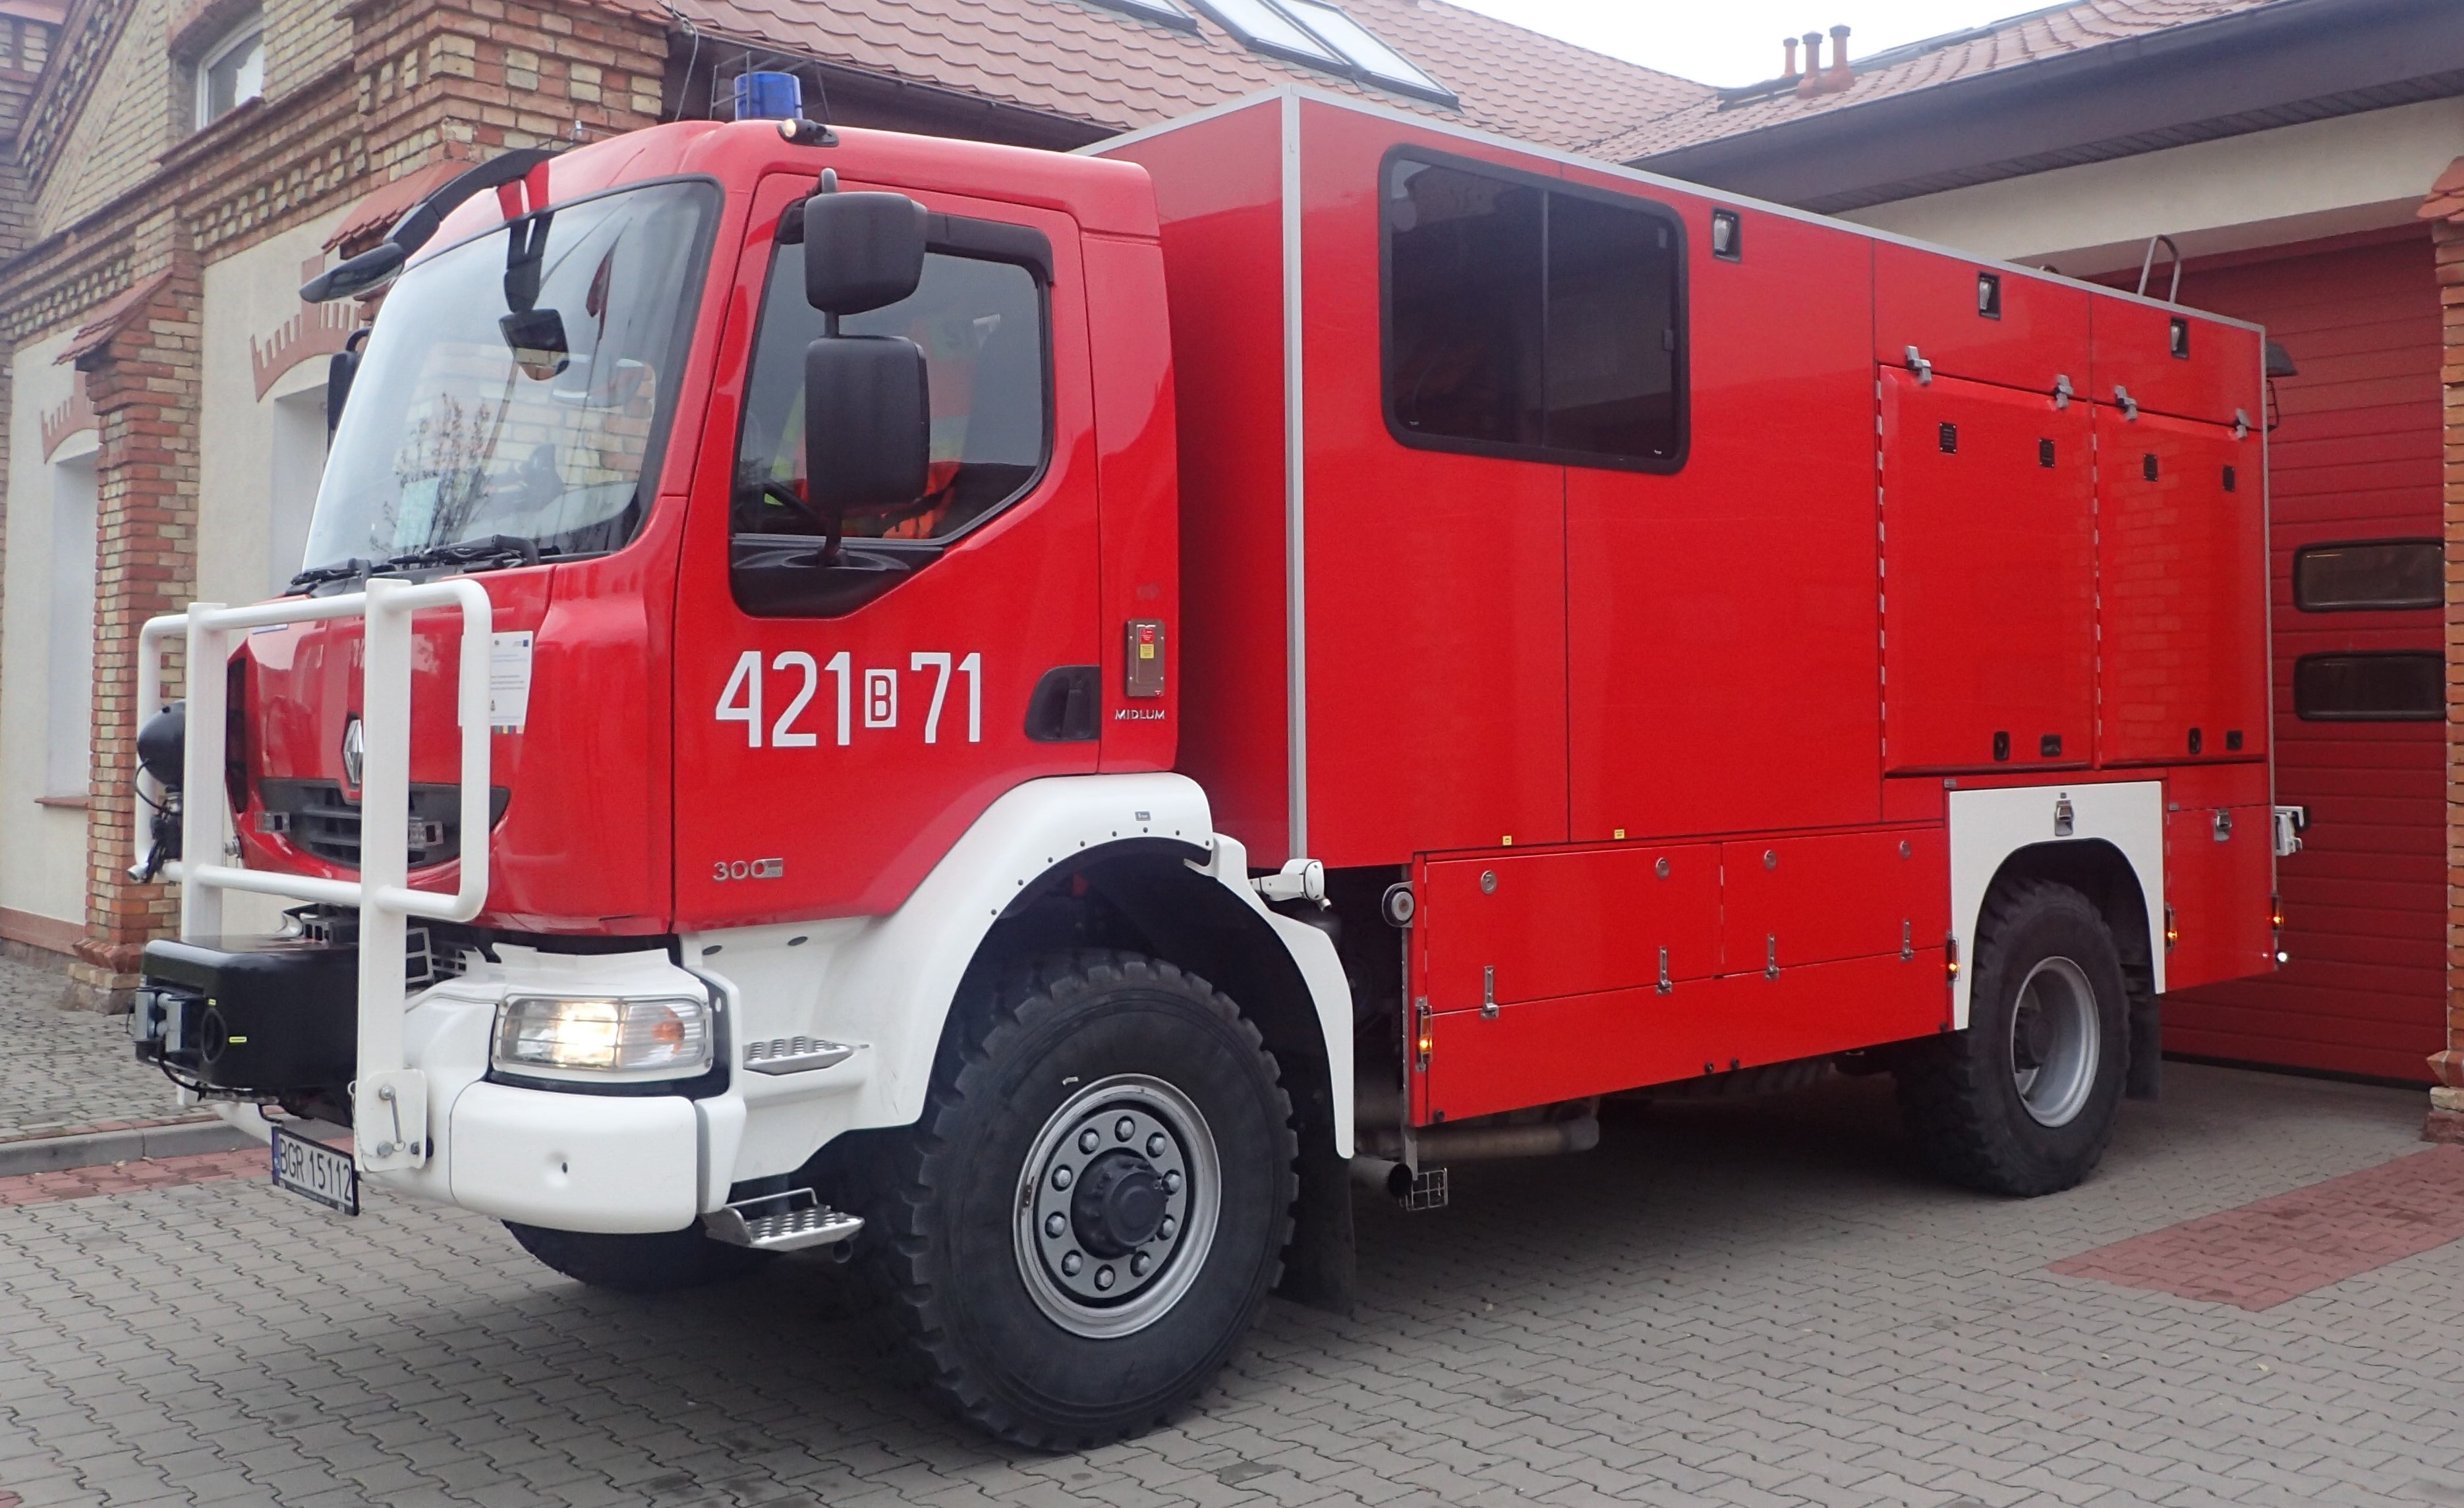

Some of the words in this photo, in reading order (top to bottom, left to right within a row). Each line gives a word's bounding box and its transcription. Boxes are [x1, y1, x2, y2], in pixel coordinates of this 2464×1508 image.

[715, 650, 851, 748] 421
[868, 673, 894, 723] B
[911, 652, 981, 744] 71
[1115, 709, 1165, 720] MIDLUM
[712, 860, 768, 881] 300
[279, 1138, 304, 1183] BGR
[309, 1150, 353, 1202] 15112
